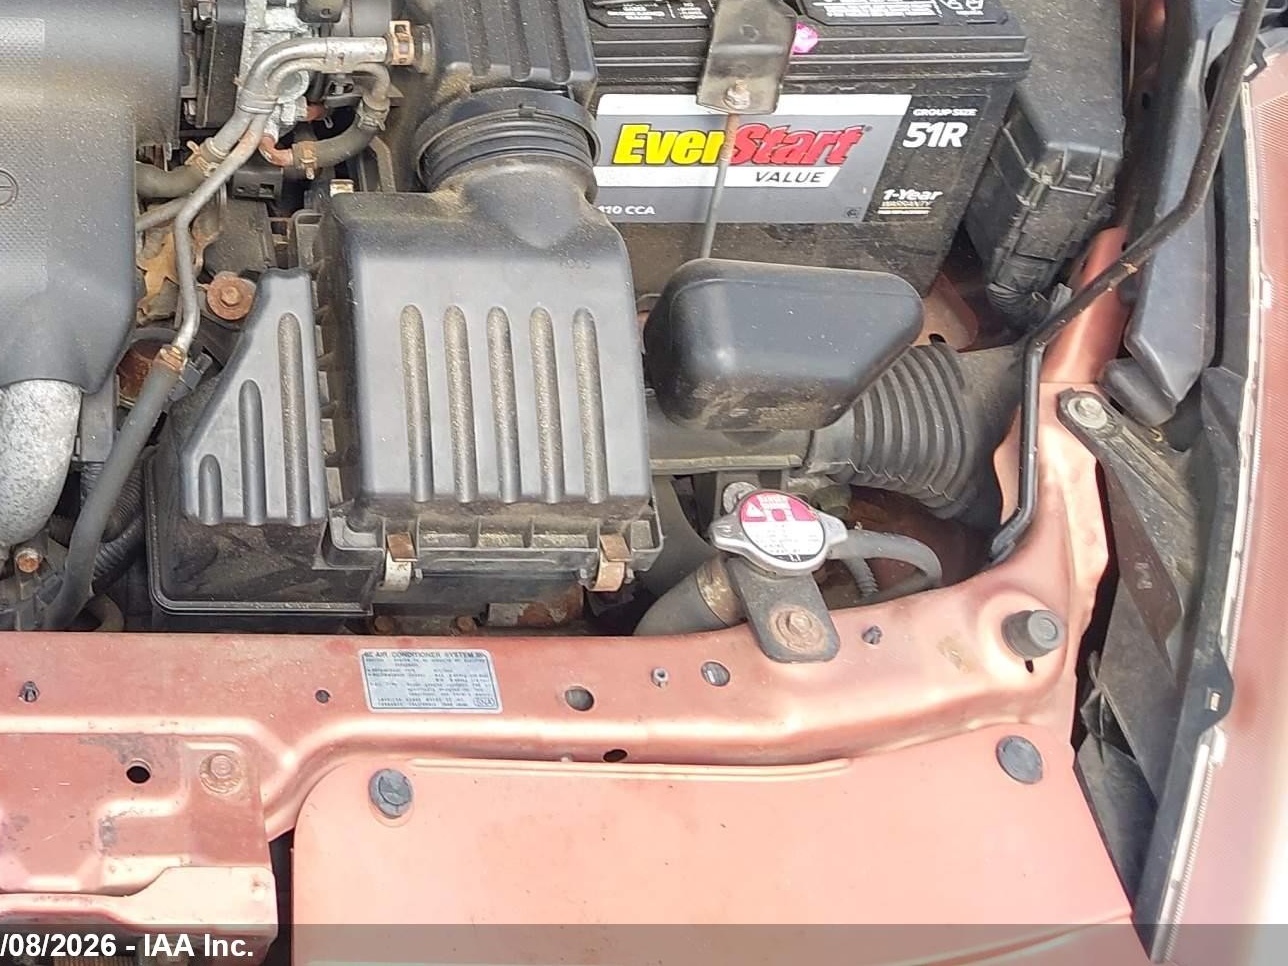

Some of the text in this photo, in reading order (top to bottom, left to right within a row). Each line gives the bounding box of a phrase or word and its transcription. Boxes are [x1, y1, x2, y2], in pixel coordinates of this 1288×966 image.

[912, 108, 978, 117] GROUP SIZE
[902, 121, 968, 148] 51R
[755, 171, 825, 183] VALUE
[883, 188, 944, 201] 1-Year
[624, 205, 657, 215] CCA
